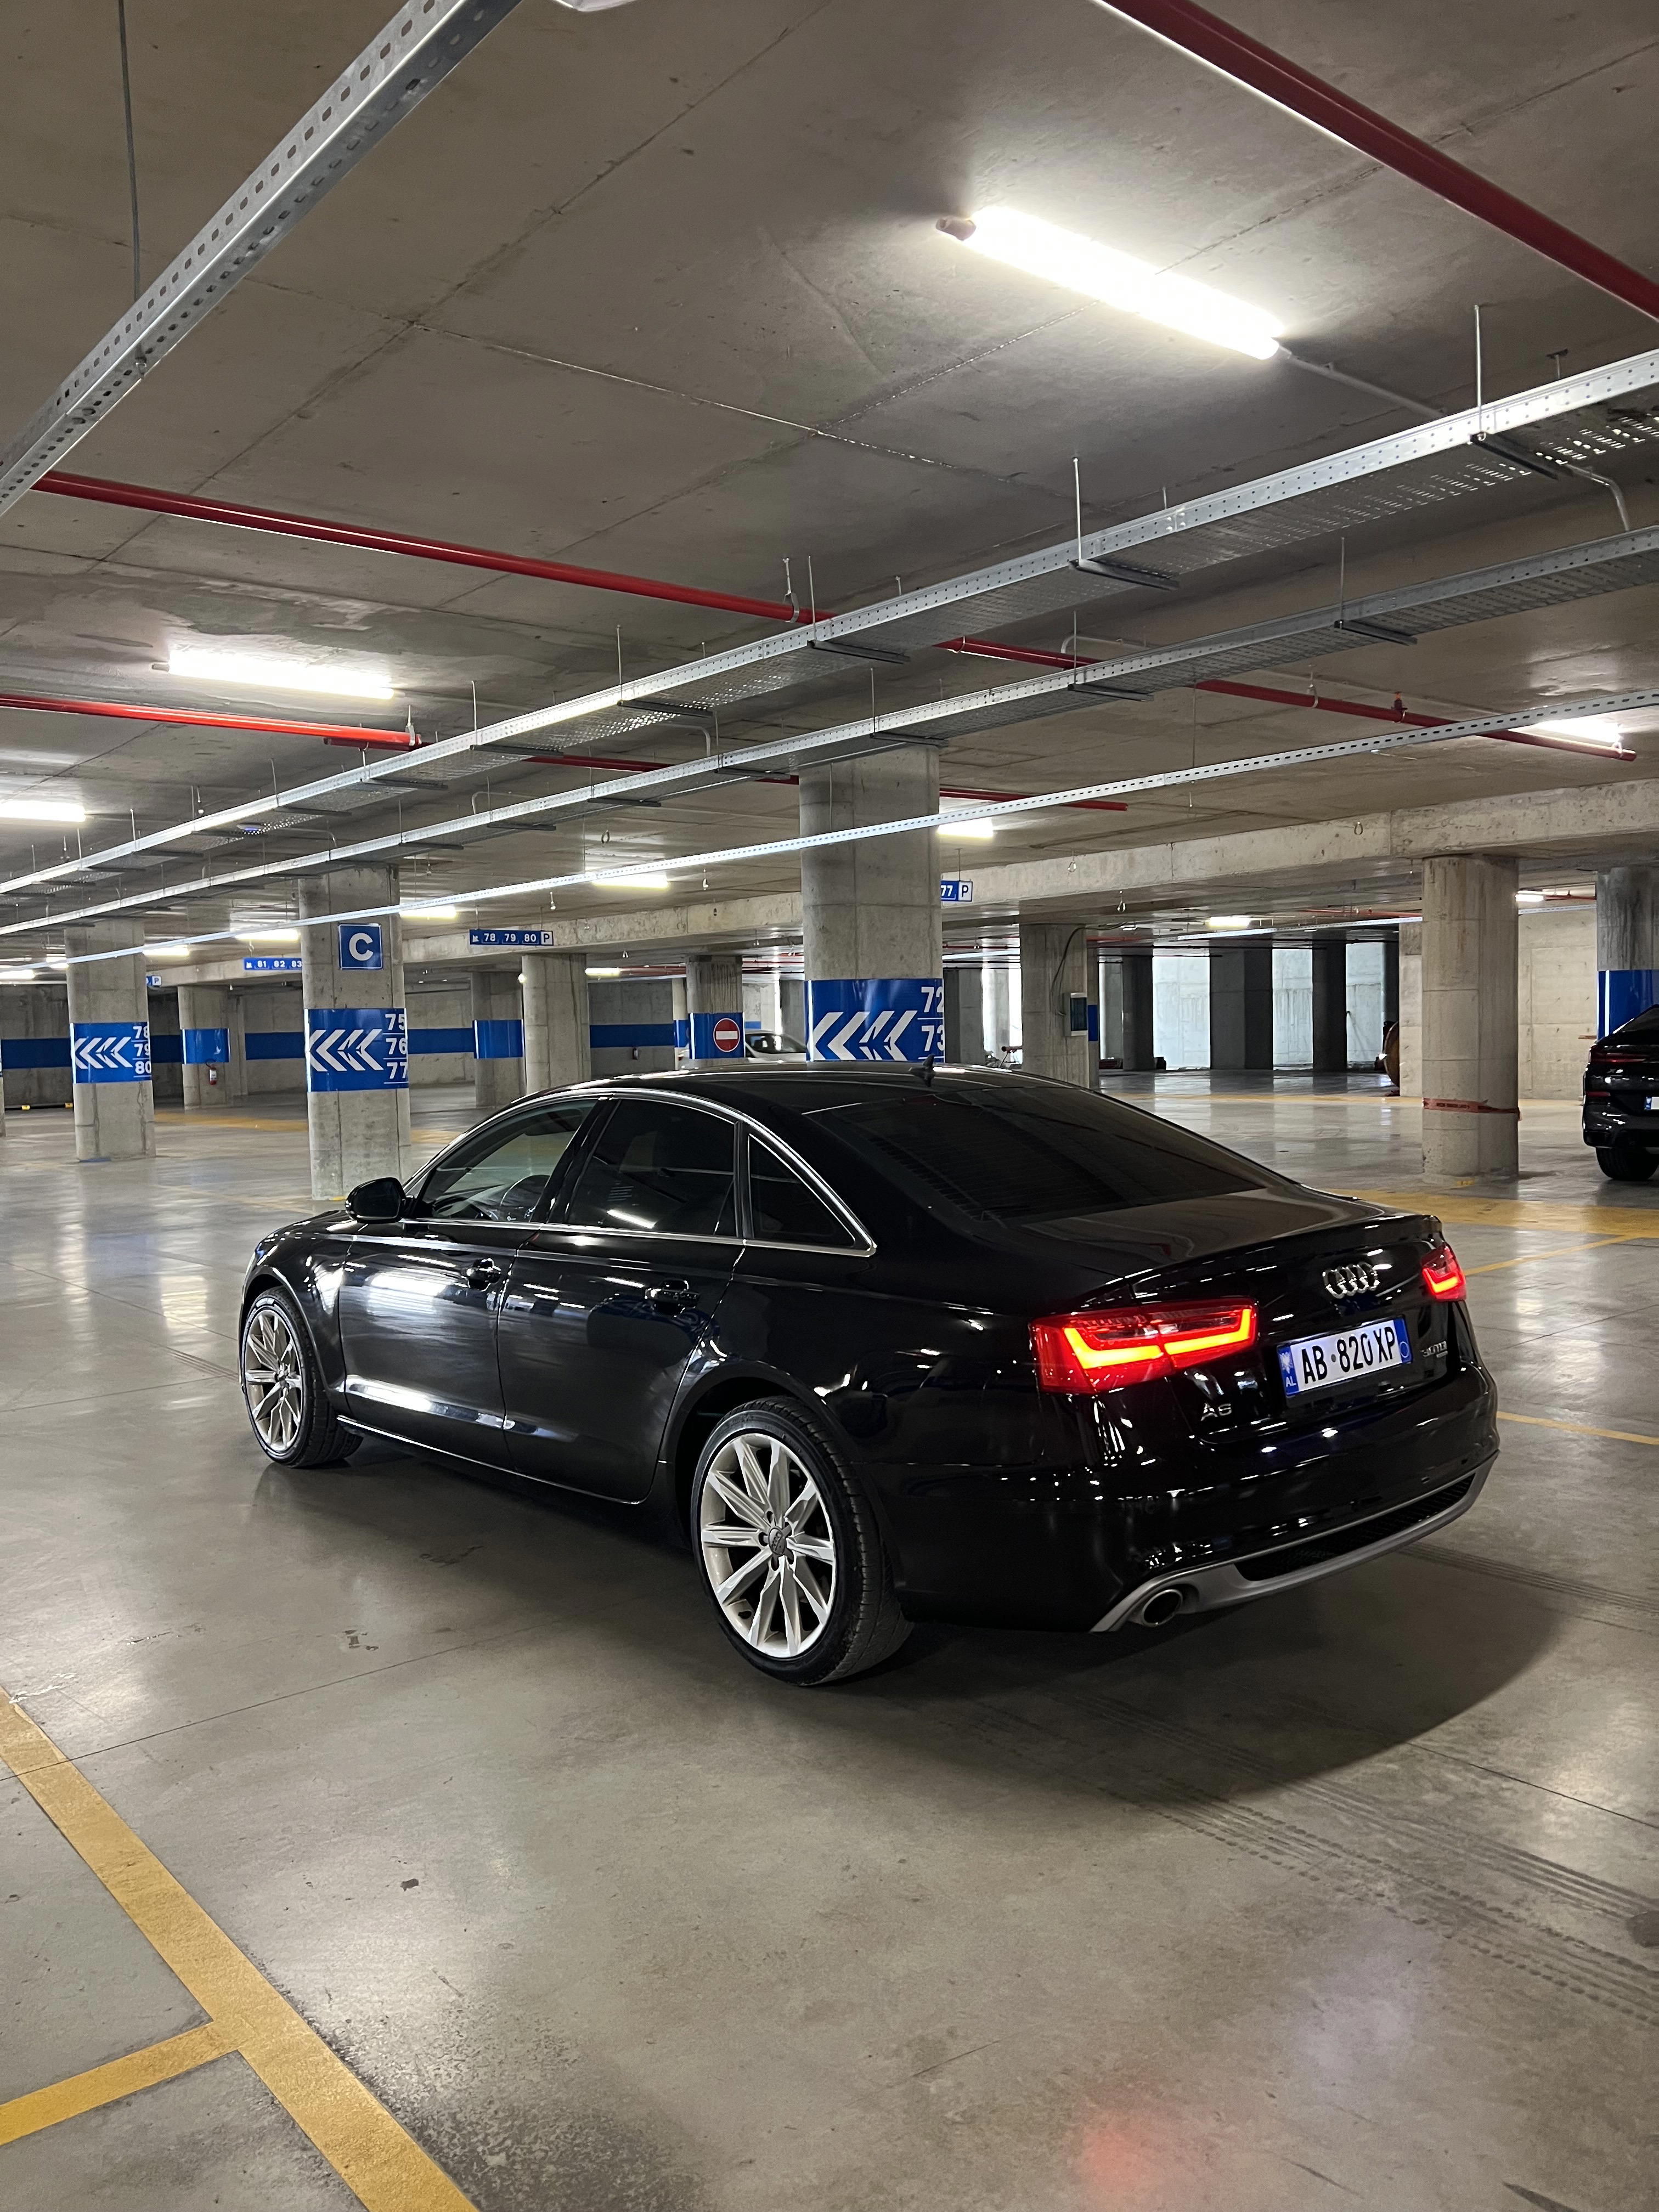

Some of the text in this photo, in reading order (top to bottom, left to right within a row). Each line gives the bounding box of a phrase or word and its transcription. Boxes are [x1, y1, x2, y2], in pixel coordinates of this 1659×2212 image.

[940, 885, 969, 898] 77 P
[483, 933, 550, 943] 78 79 80 P
[349, 933, 374, 961] C
[921, 986, 944, 1013] 72
[385, 1013, 407, 1031] 75
[133, 1025, 150, 1039] 78
[921, 1024, 945, 1052] 73
[134, 1043, 151, 1057] 79
[386, 1037, 408, 1055] 76
[135, 1060, 152, 1075] 80
[386, 1062, 408, 1079] 77
[1301, 1326, 1396, 1384] AB 820 XP
[1285, 1376, 1297, 1387] AL
[1200, 1403, 1232, 1421] A6
